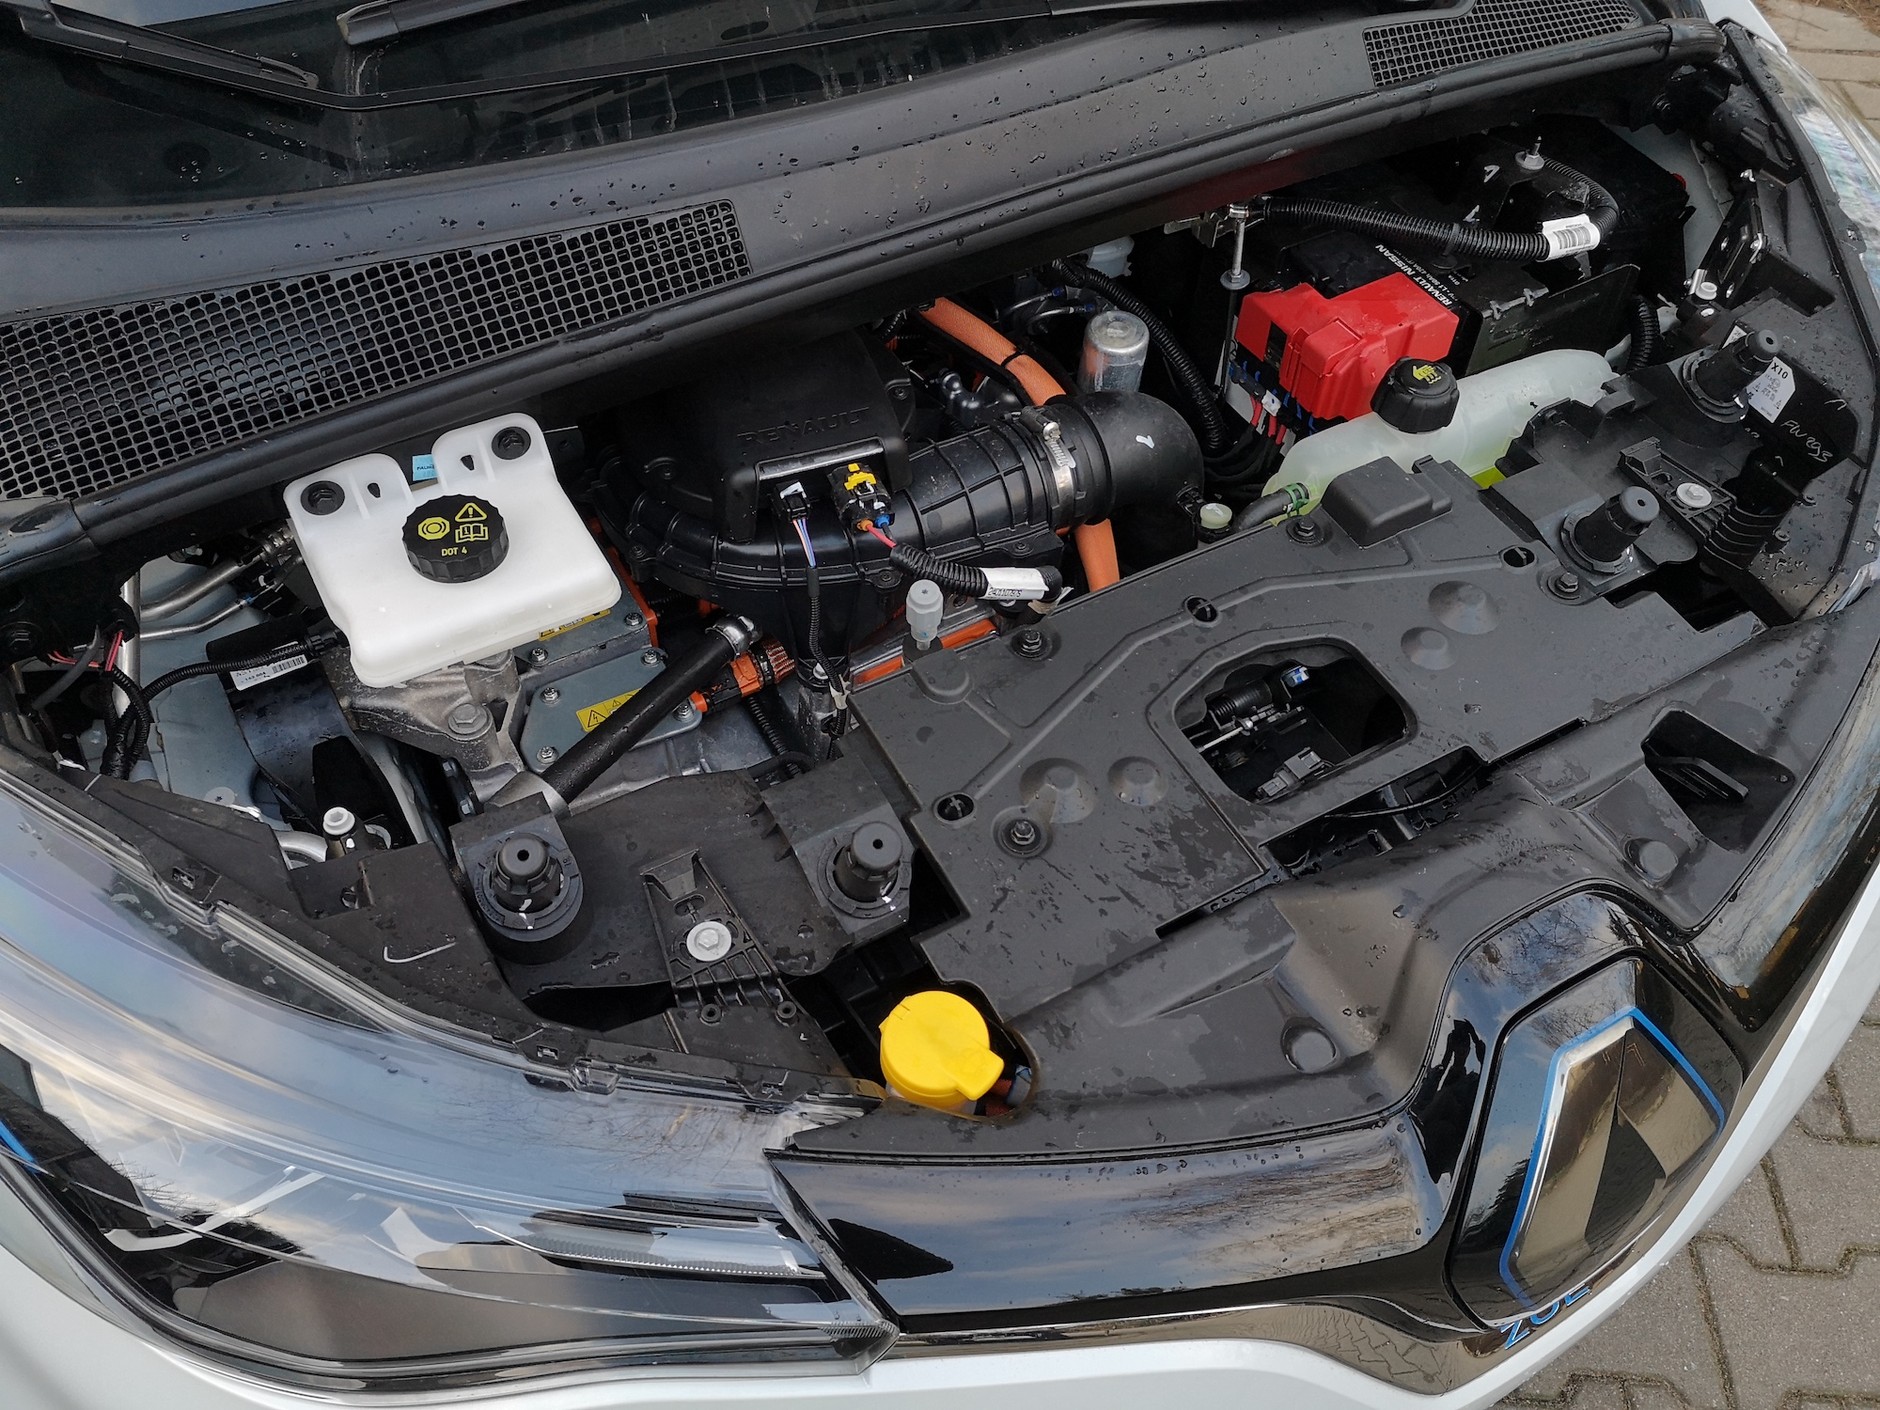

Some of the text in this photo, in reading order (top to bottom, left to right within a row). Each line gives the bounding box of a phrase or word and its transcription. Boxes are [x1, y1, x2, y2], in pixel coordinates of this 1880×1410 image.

[1375, 244, 1416, 276] NISSAN
[1413, 276, 1453, 306] RENAULT
[1771, 362, 1789, 380] X10
[441, 546, 468, 557] DOT 4
